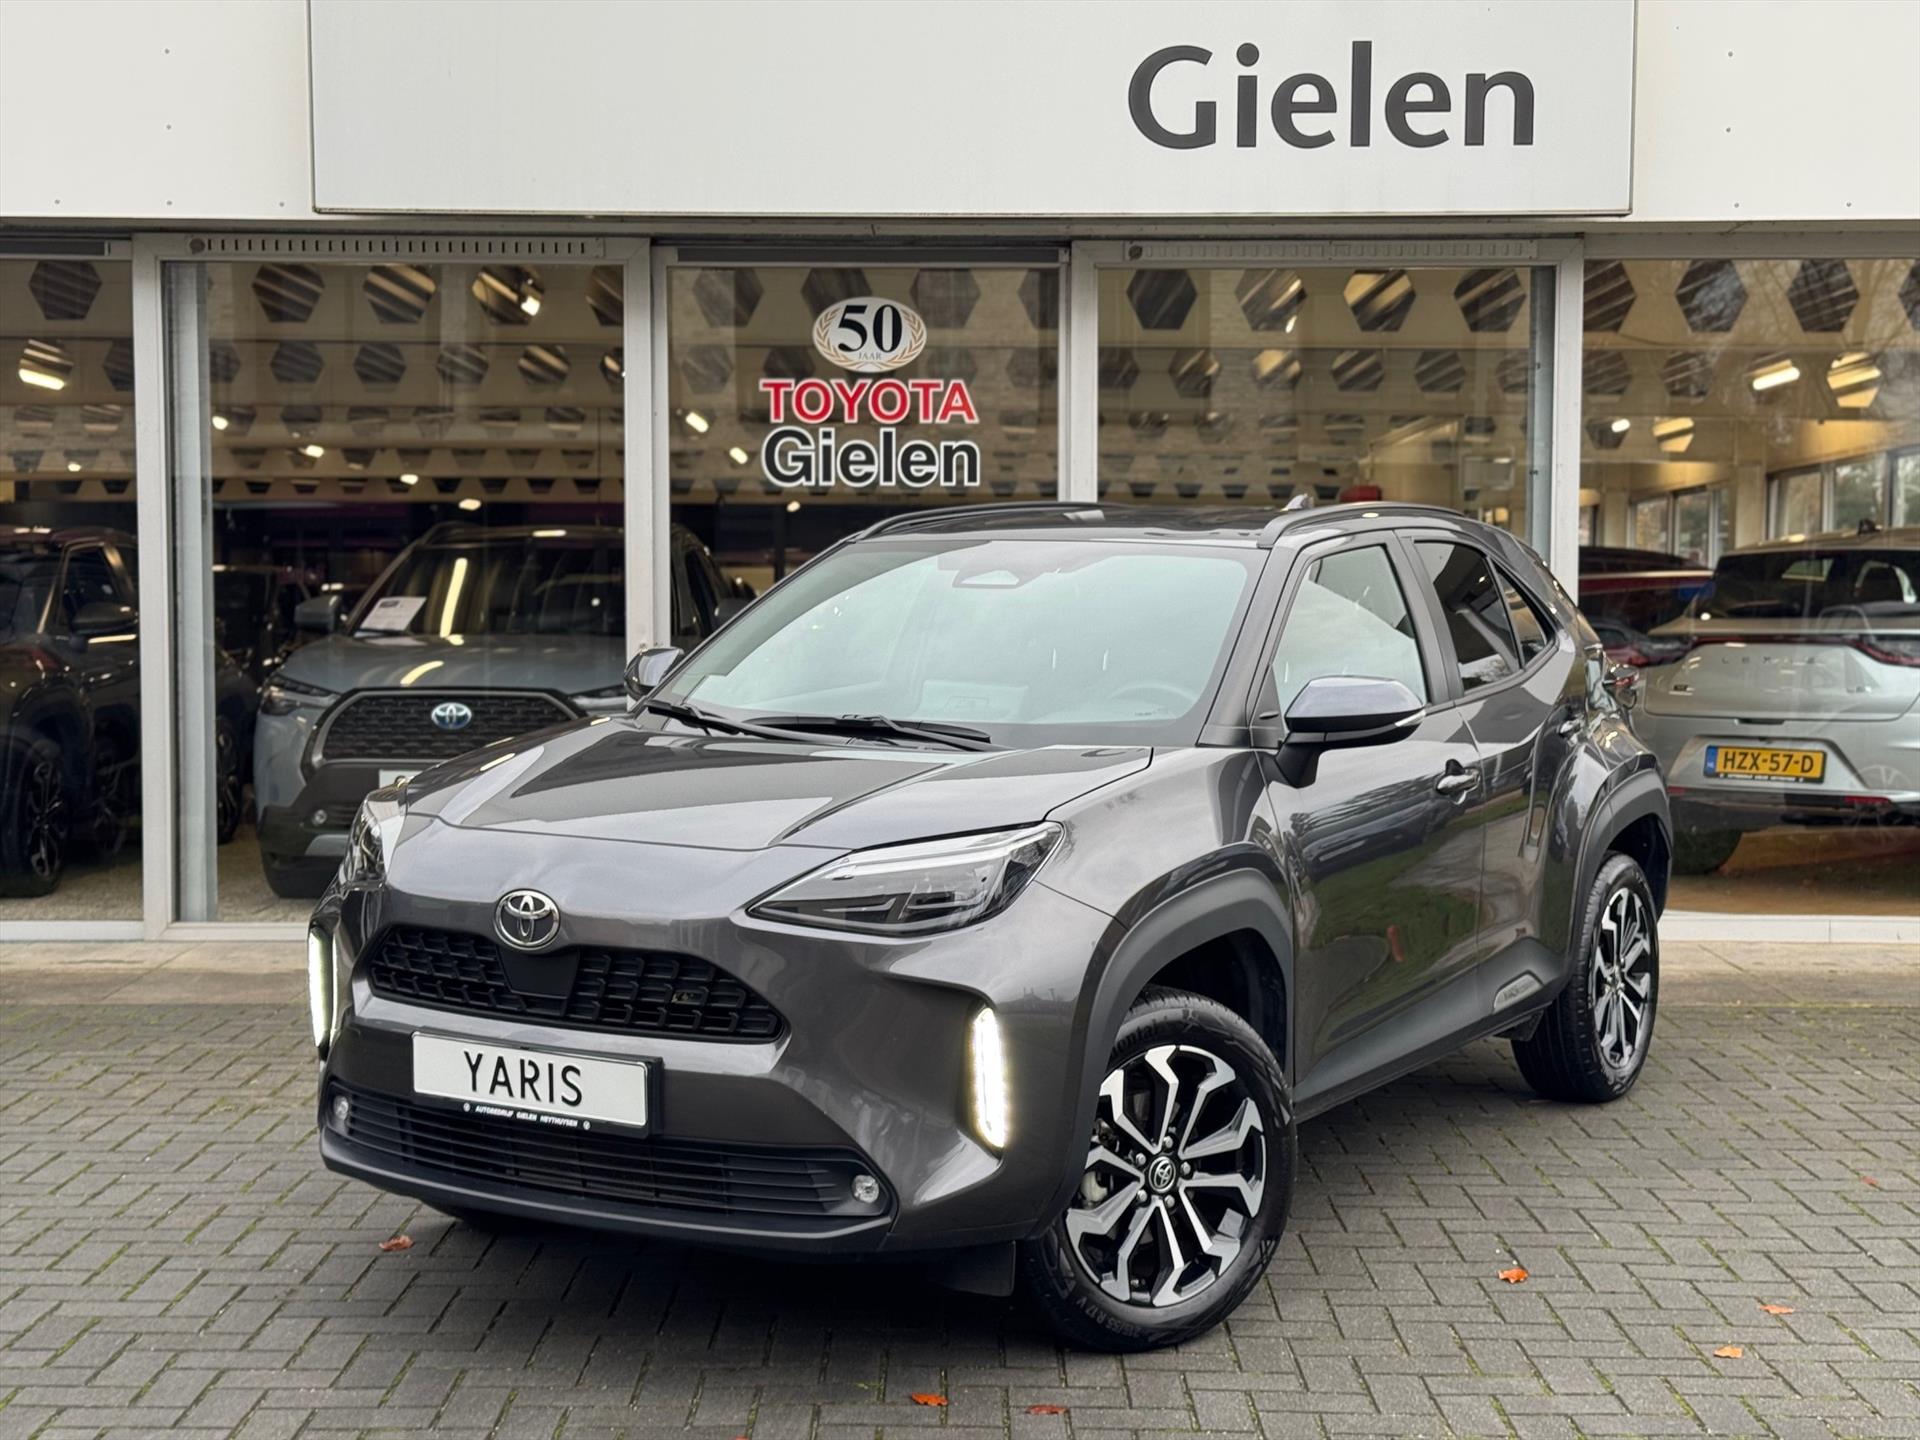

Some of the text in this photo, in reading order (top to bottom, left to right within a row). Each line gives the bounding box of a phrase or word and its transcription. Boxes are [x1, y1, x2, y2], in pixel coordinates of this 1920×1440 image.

[1127, 40, 1535, 150] Gielen
[838, 304, 902, 352] 50
[858, 352, 882, 361] JAAR
[760, 380, 978, 423] TOYOTA
[763, 427, 979, 486] Gielen
[1722, 751, 1815, 774] HZX-57-D
[464, 1051, 582, 1107] YARIS
[516, 1111, 537, 1120] GIELEN
